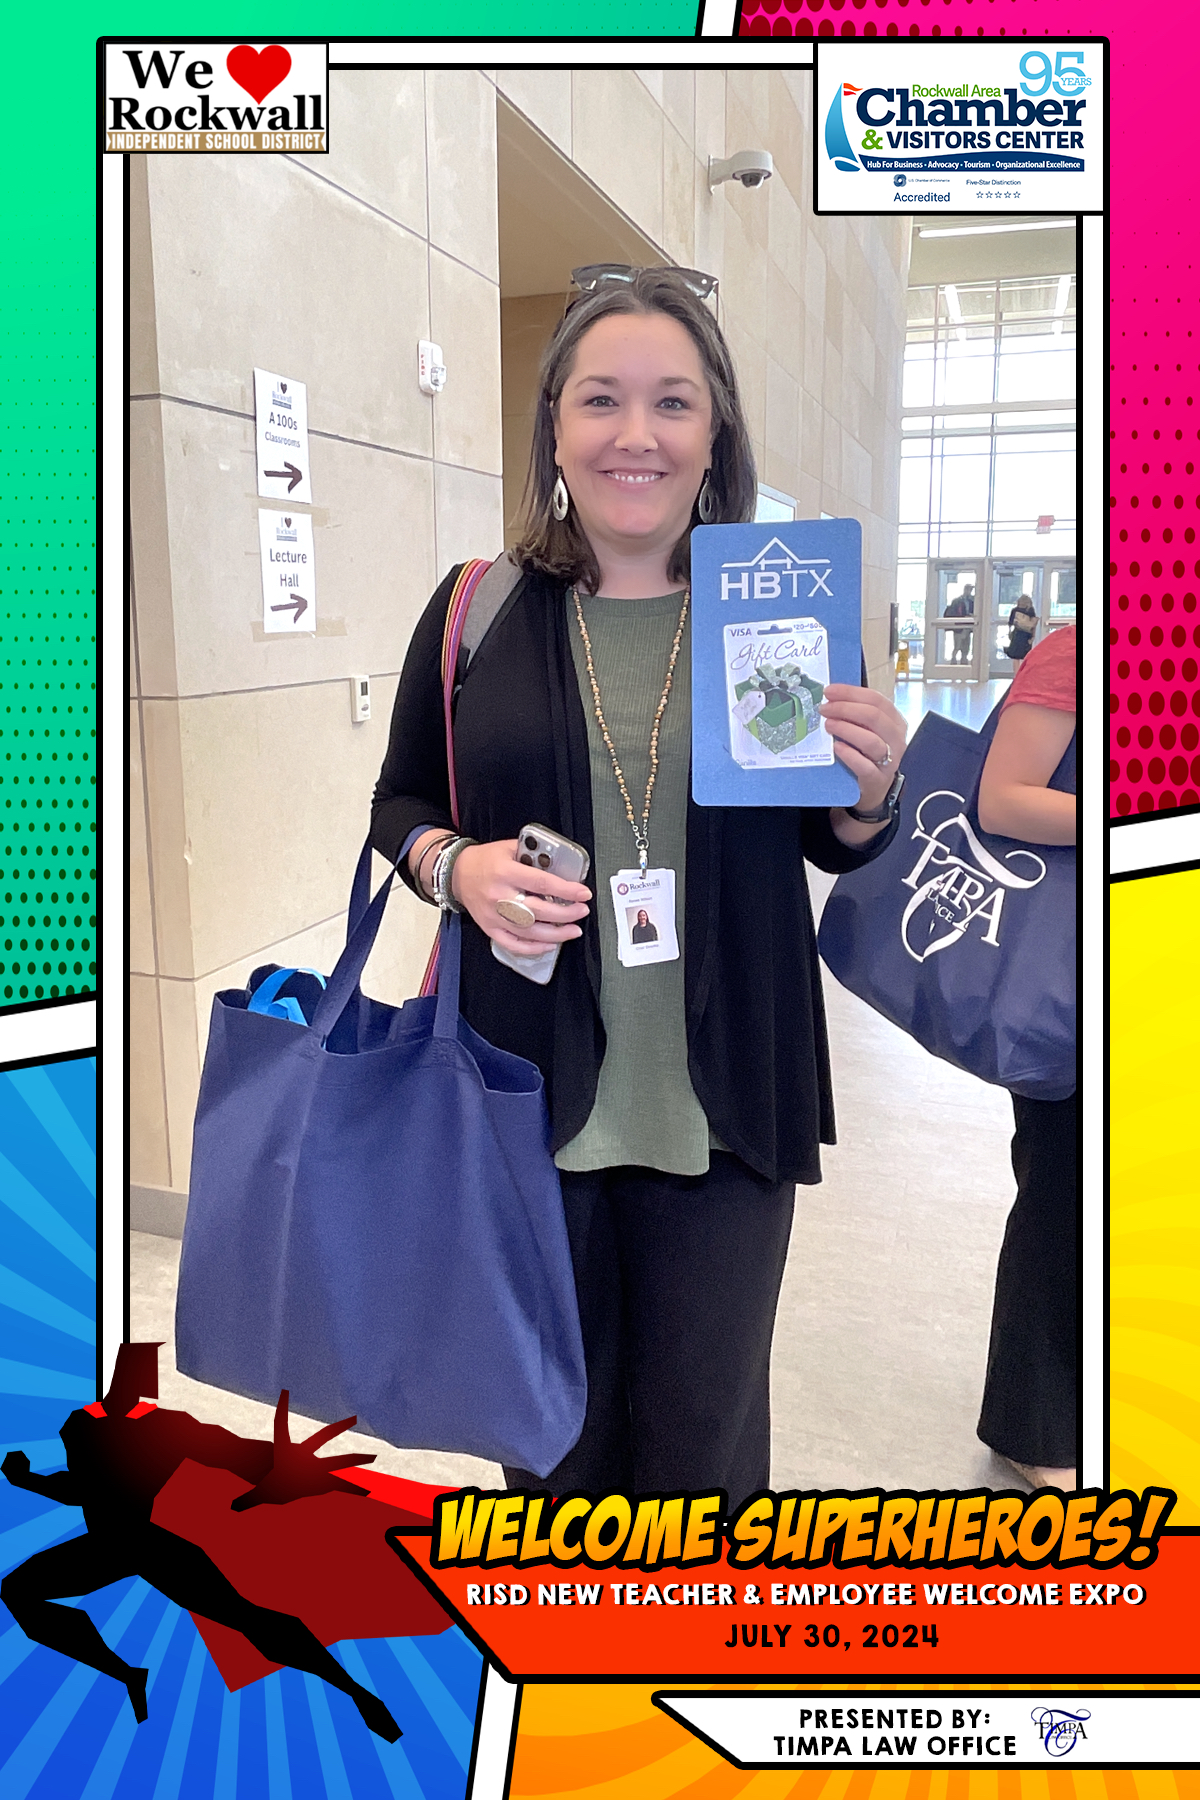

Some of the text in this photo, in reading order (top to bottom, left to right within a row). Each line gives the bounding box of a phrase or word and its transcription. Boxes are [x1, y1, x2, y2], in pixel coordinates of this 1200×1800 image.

[269, 411, 298, 431] A 100s
[264, 431, 301, 449] Classrooms
[269, 547, 307, 564] Lecture
[279, 573, 300, 588] Hall
[720, 568, 834, 601] HBTX
[729, 627, 752, 637] VISA
[773, 635, 823, 660] Card
[629, 878, 661, 890] Rockwall
